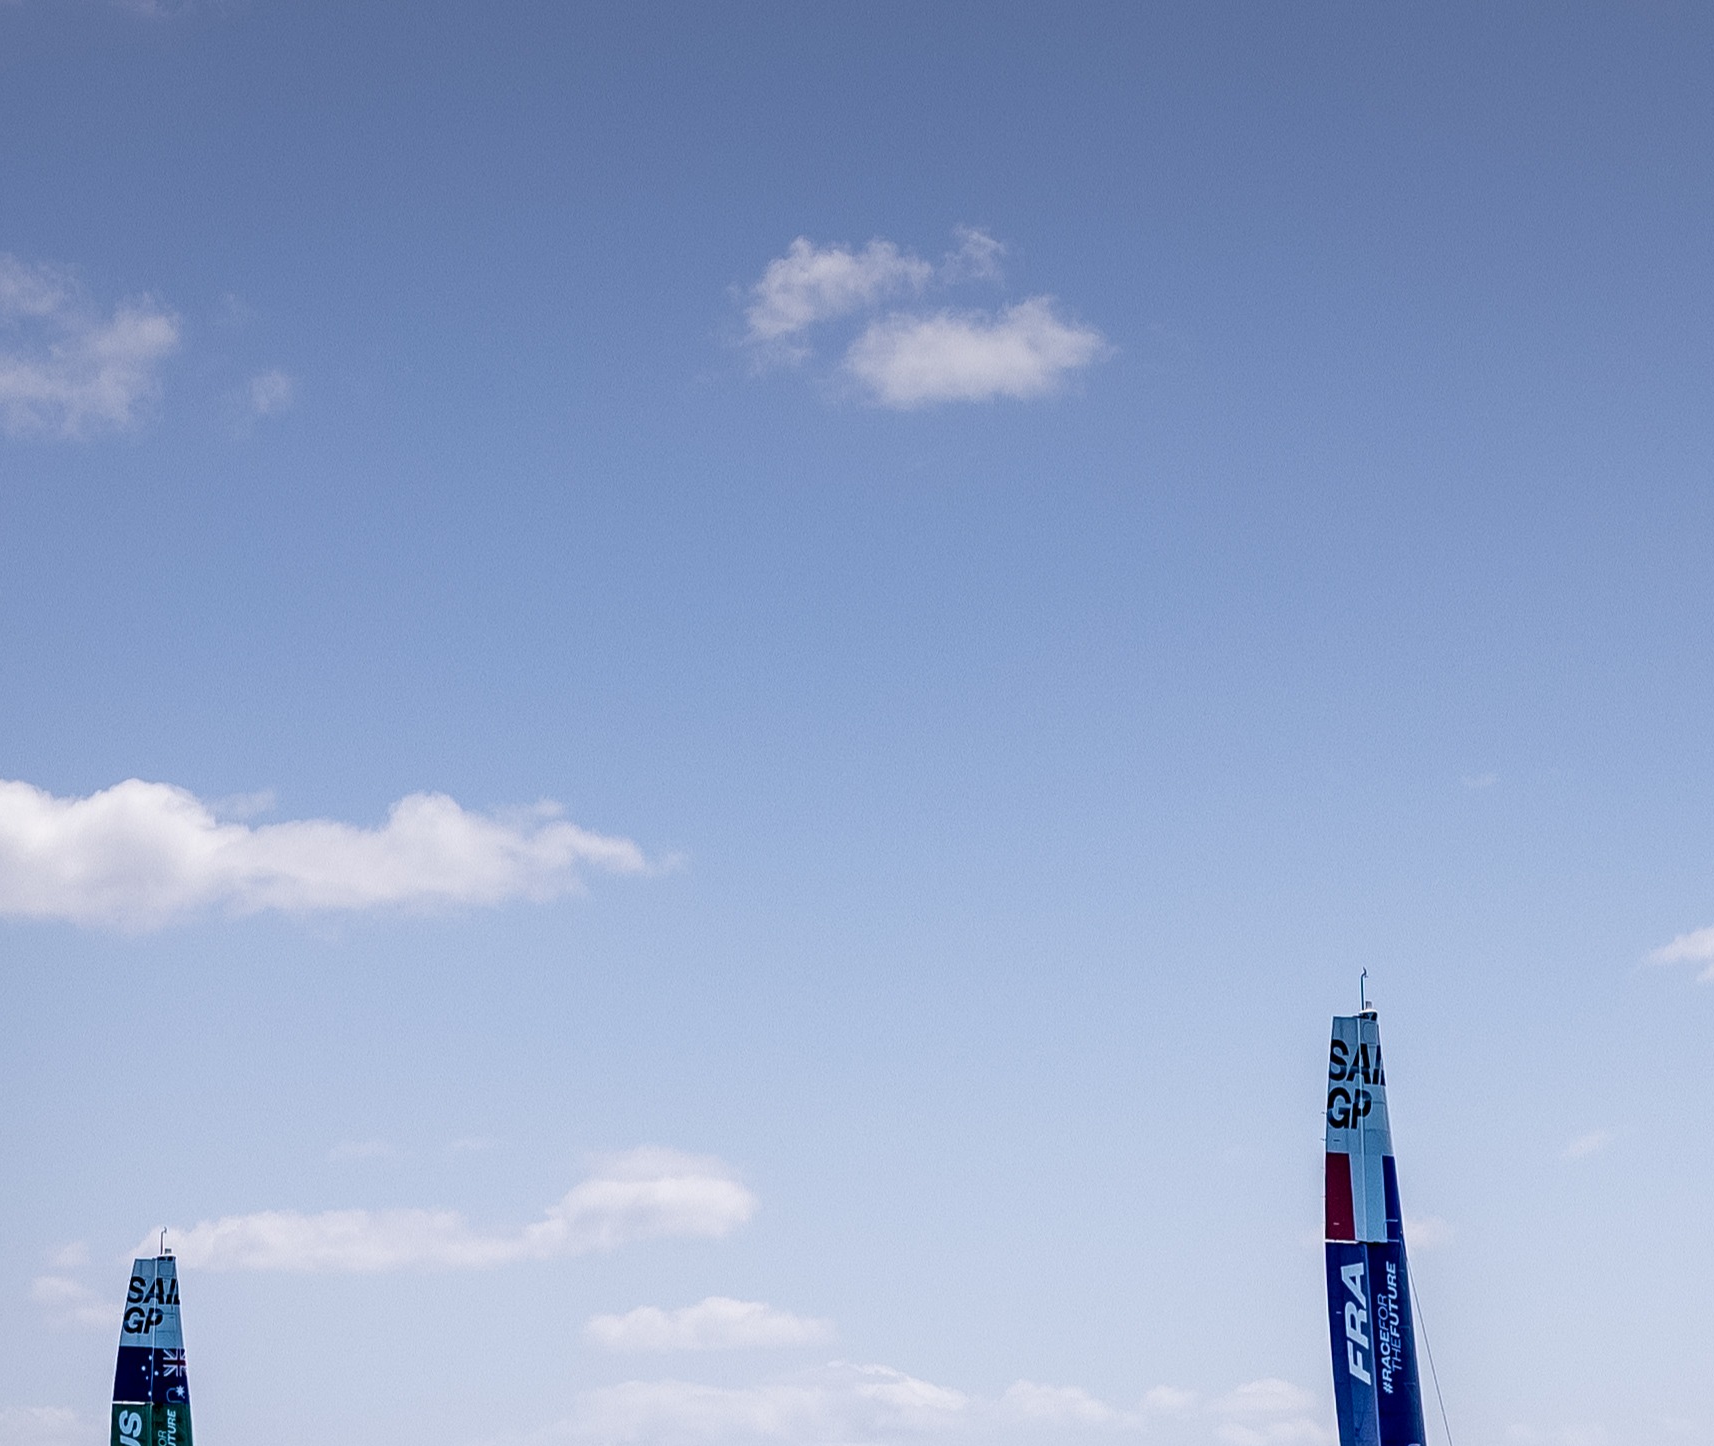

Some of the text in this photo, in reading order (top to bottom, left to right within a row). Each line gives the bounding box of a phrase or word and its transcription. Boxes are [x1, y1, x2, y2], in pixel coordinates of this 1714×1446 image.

[1327, 1087, 1371, 1130] GP
[123, 1307, 163, 1334] GP
[1341, 1262, 1372, 1386] FRA
[1377, 1293, 1394, 1394] #RACEFOR
[1386, 1262, 1402, 1371] THEFUTURE
